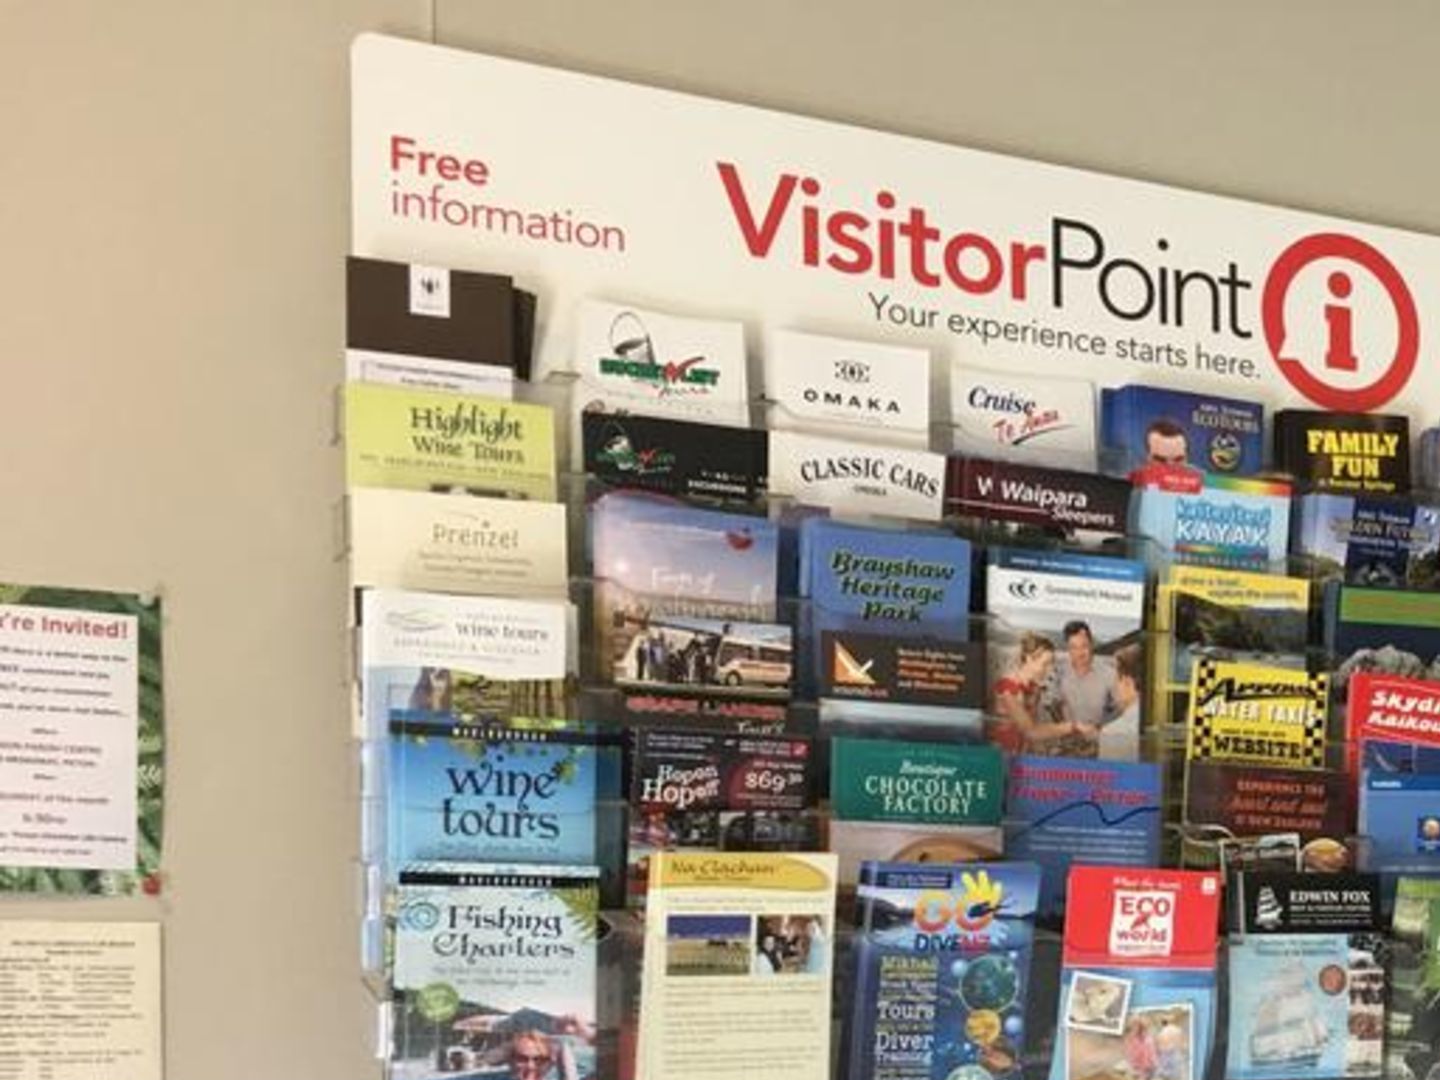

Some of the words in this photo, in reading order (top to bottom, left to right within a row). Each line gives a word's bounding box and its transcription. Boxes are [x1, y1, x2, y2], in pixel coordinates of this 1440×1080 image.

[389, 135, 489, 186] Free
[392, 181, 625, 252] information
[717, 162, 1252, 338] VisitorPoint
[869, 292, 940, 328] Your
[948, 315, 1106, 355] experience
[1115, 337, 1188, 367] starts
[1195, 344, 1261, 380] here.
[803, 389, 900, 414] OMAKA
[969, 386, 1036, 415] Cruise
[410, 403, 523, 444] Highlight
[412, 435, 464, 457] Wine
[472, 440, 525, 466] Tours
[1307, 430, 1399, 457] FAMILY
[801, 456, 883, 483] CLASSIC
[889, 463, 940, 498] CARS
[1332, 455, 1379, 478] FUN
[1002, 480, 1087, 508] Waipara
[1051, 503, 1114, 526] Sleepers
[433, 523, 519, 549] Prenzel
[1176, 520, 1268, 547] KAYAK
[831, 549, 956, 582] Brayshaw
[841, 578, 944, 604] Heritage
[862, 602, 921, 624] Park
[41, 615, 129, 641] Invited!
[1212, 736, 1301, 758] WEBSITE
[446, 754, 558, 811] wine
[866, 776, 988, 798] CHOCOLATE
[441, 798, 560, 840] tours
[884, 795, 971, 816] FACTORY
[1120, 896, 1170, 917] ECO
[1289, 890, 1337, 904] EDWIN
[1341, 890, 1371, 904] FOX
[448, 903, 563, 945] Fishing
[1117, 927, 1167, 944] world
[432, 931, 575, 965] Charters
[876, 1032, 933, 1051] Diver
